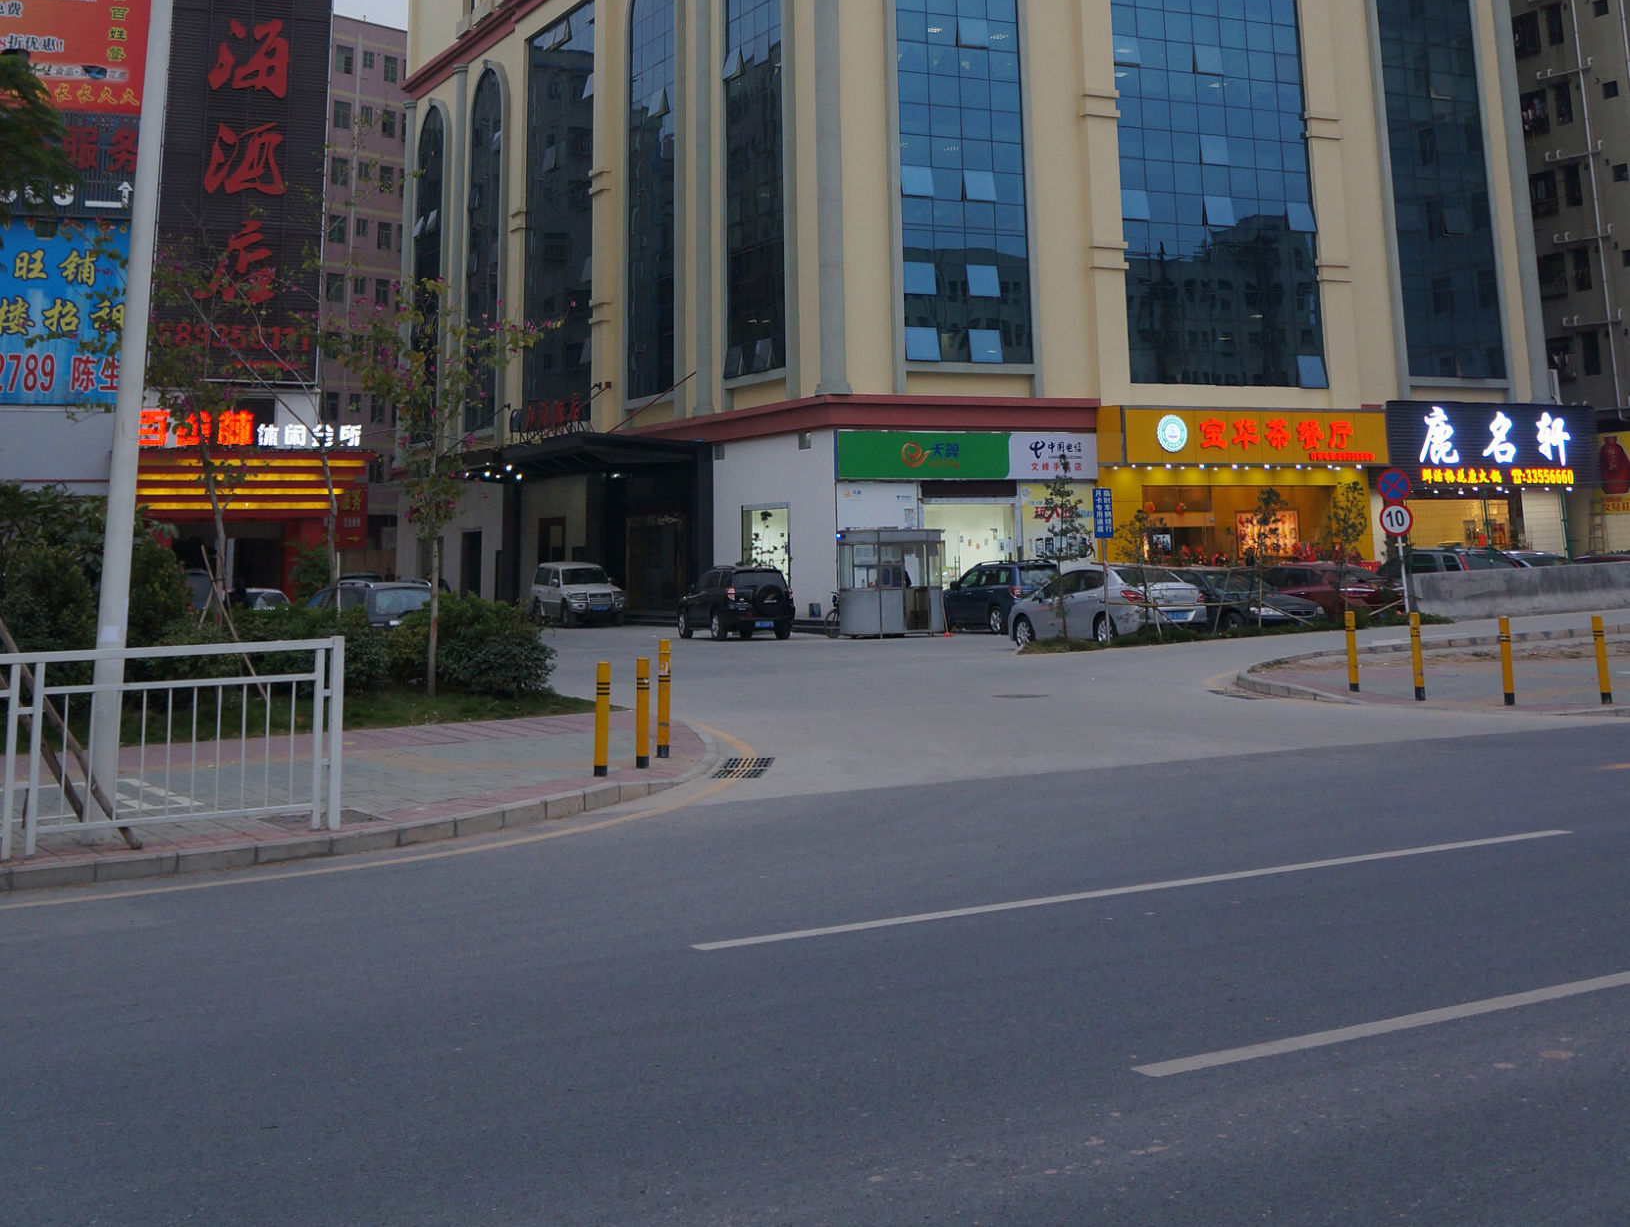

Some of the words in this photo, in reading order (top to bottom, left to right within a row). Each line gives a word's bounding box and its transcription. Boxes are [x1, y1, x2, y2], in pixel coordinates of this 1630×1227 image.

[13, 248, 98, 287] 旺铺
[1199, 417, 1354, 451] 宝华茶餐厅
[1418, 406, 1571, 466] 鹿名轩
[931, 442, 960, 460] 天翼
[1047, 441, 1082, 454] 中国电信
[1386, 510, 1405, 528] 10
